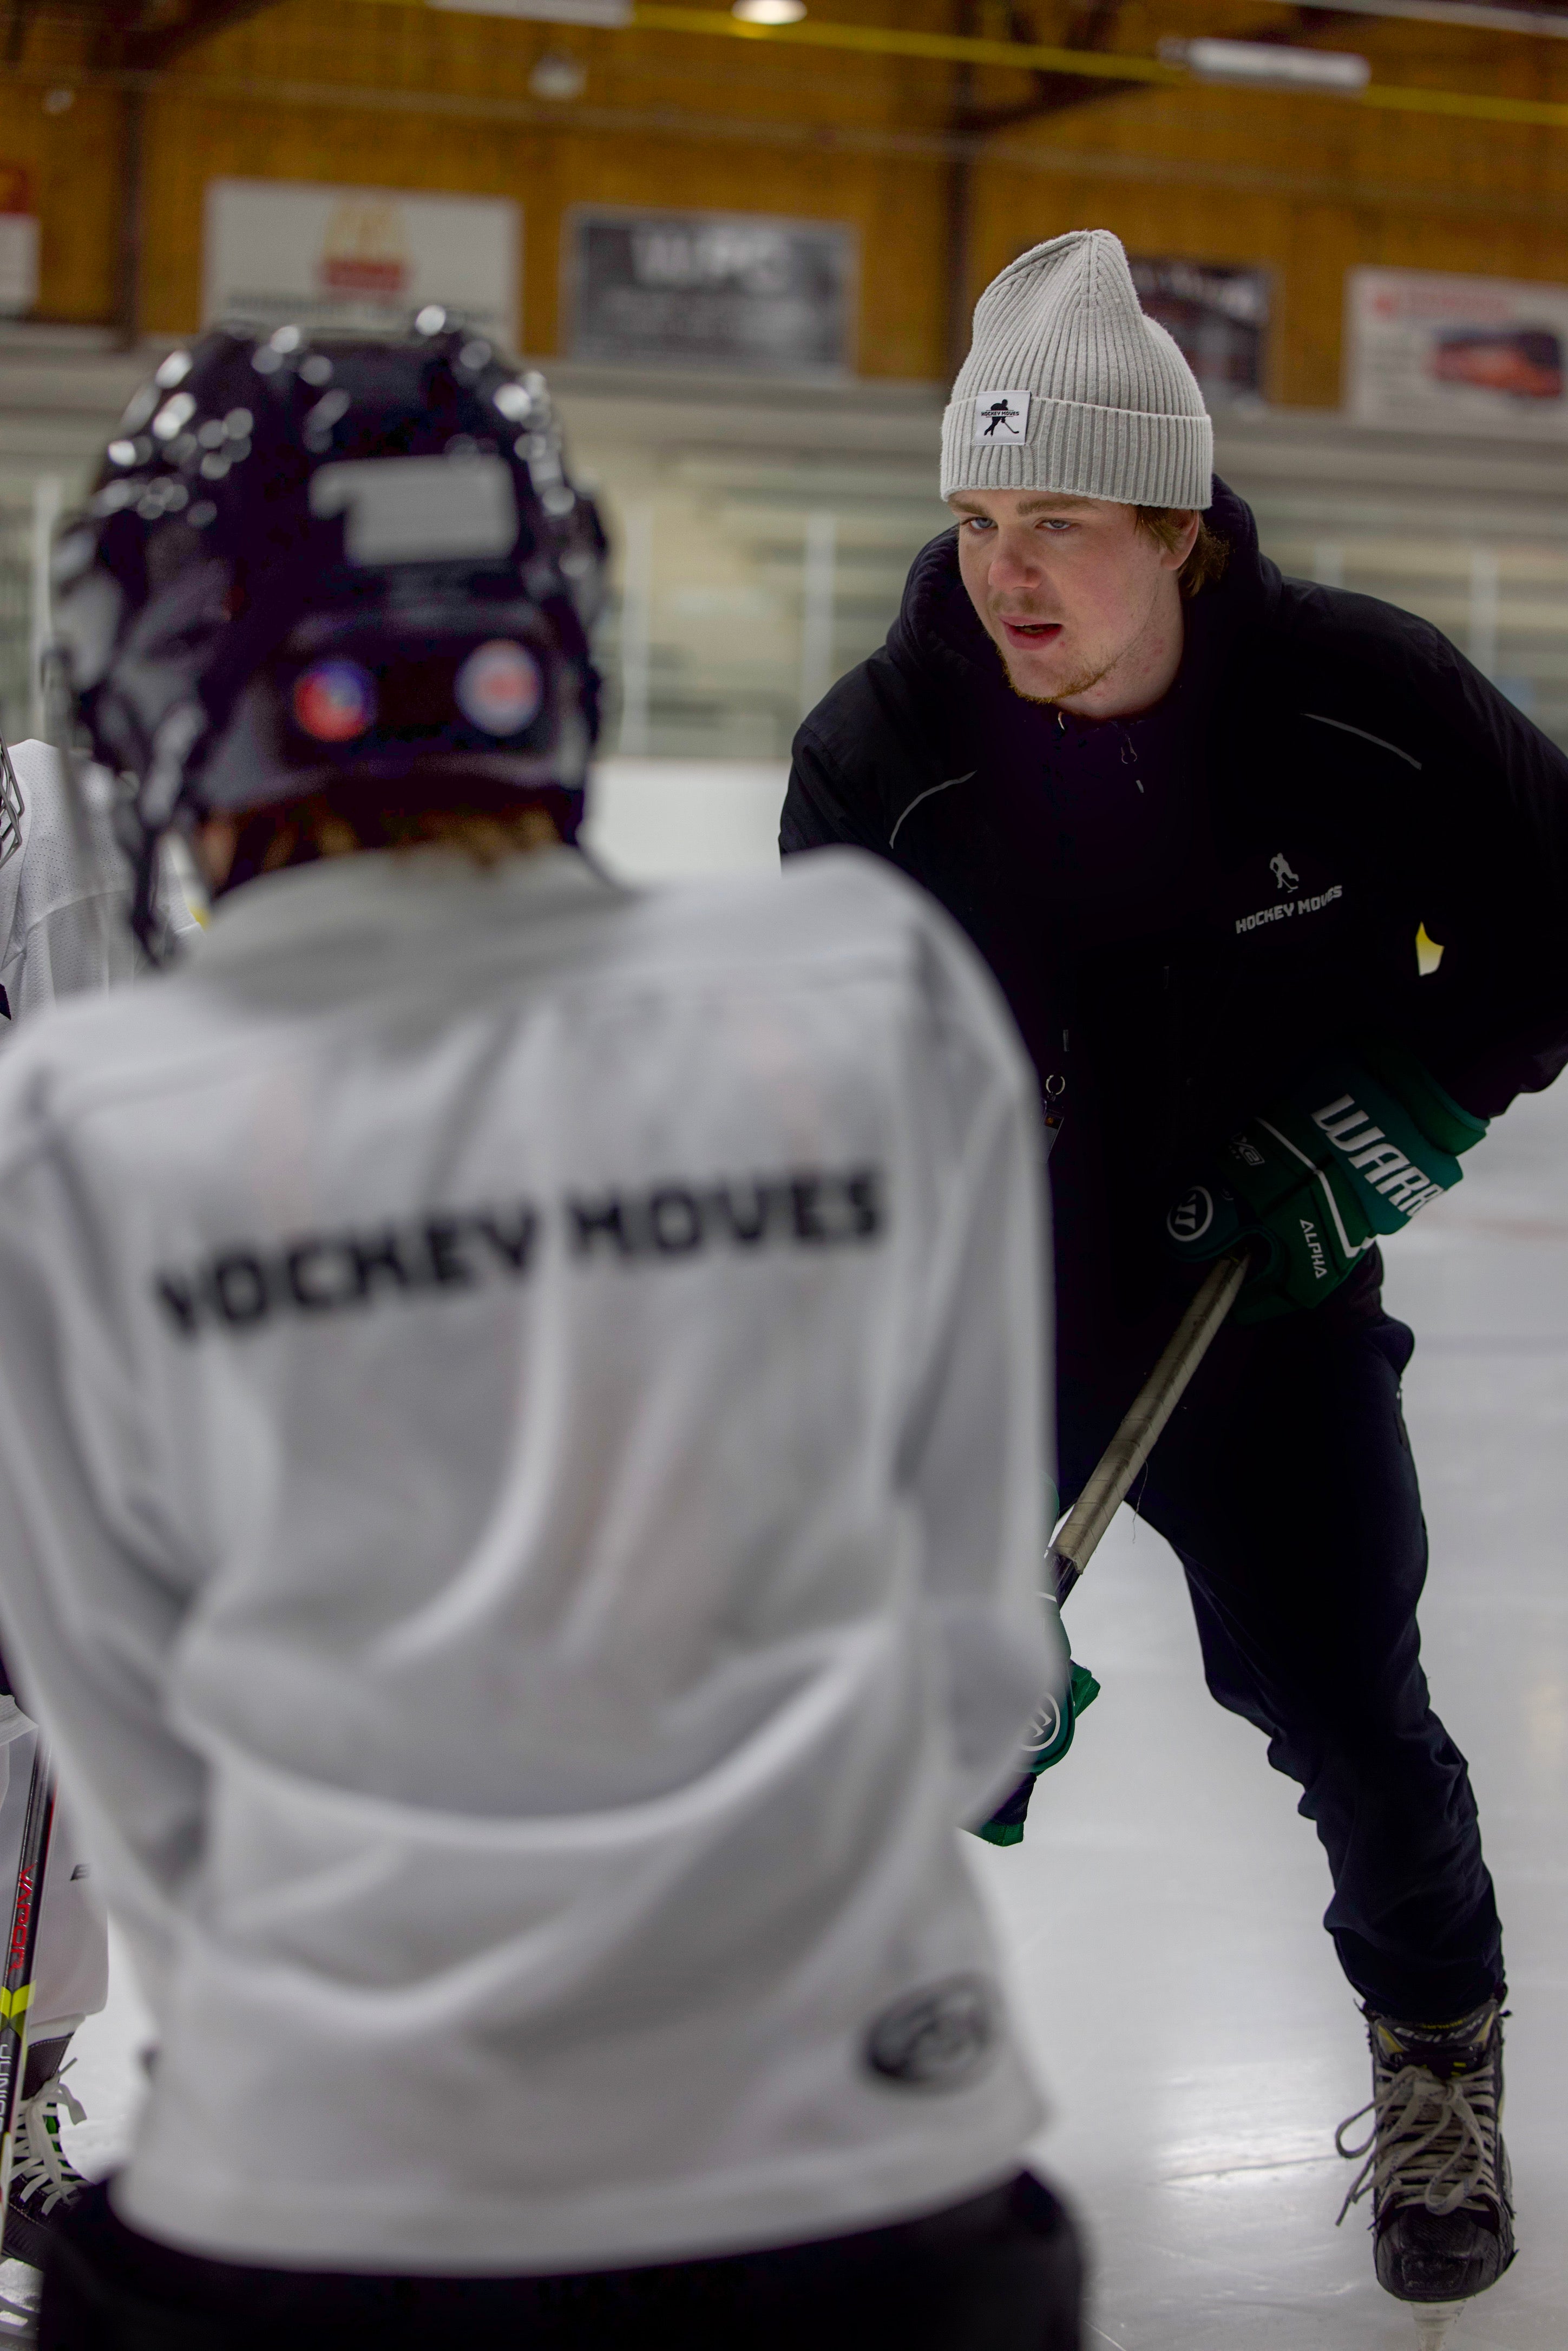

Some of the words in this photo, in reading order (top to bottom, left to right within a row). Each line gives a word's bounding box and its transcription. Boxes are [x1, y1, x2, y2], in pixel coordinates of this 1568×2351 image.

[1236, 902, 1294, 934] HOCKEY
[1298, 885, 1342, 914] MOVES
[569, 1167, 886, 1259] MOVES
[1300, 1219, 1327, 1279] ALPHA
[8, 1860, 38, 1976] VAPOR
